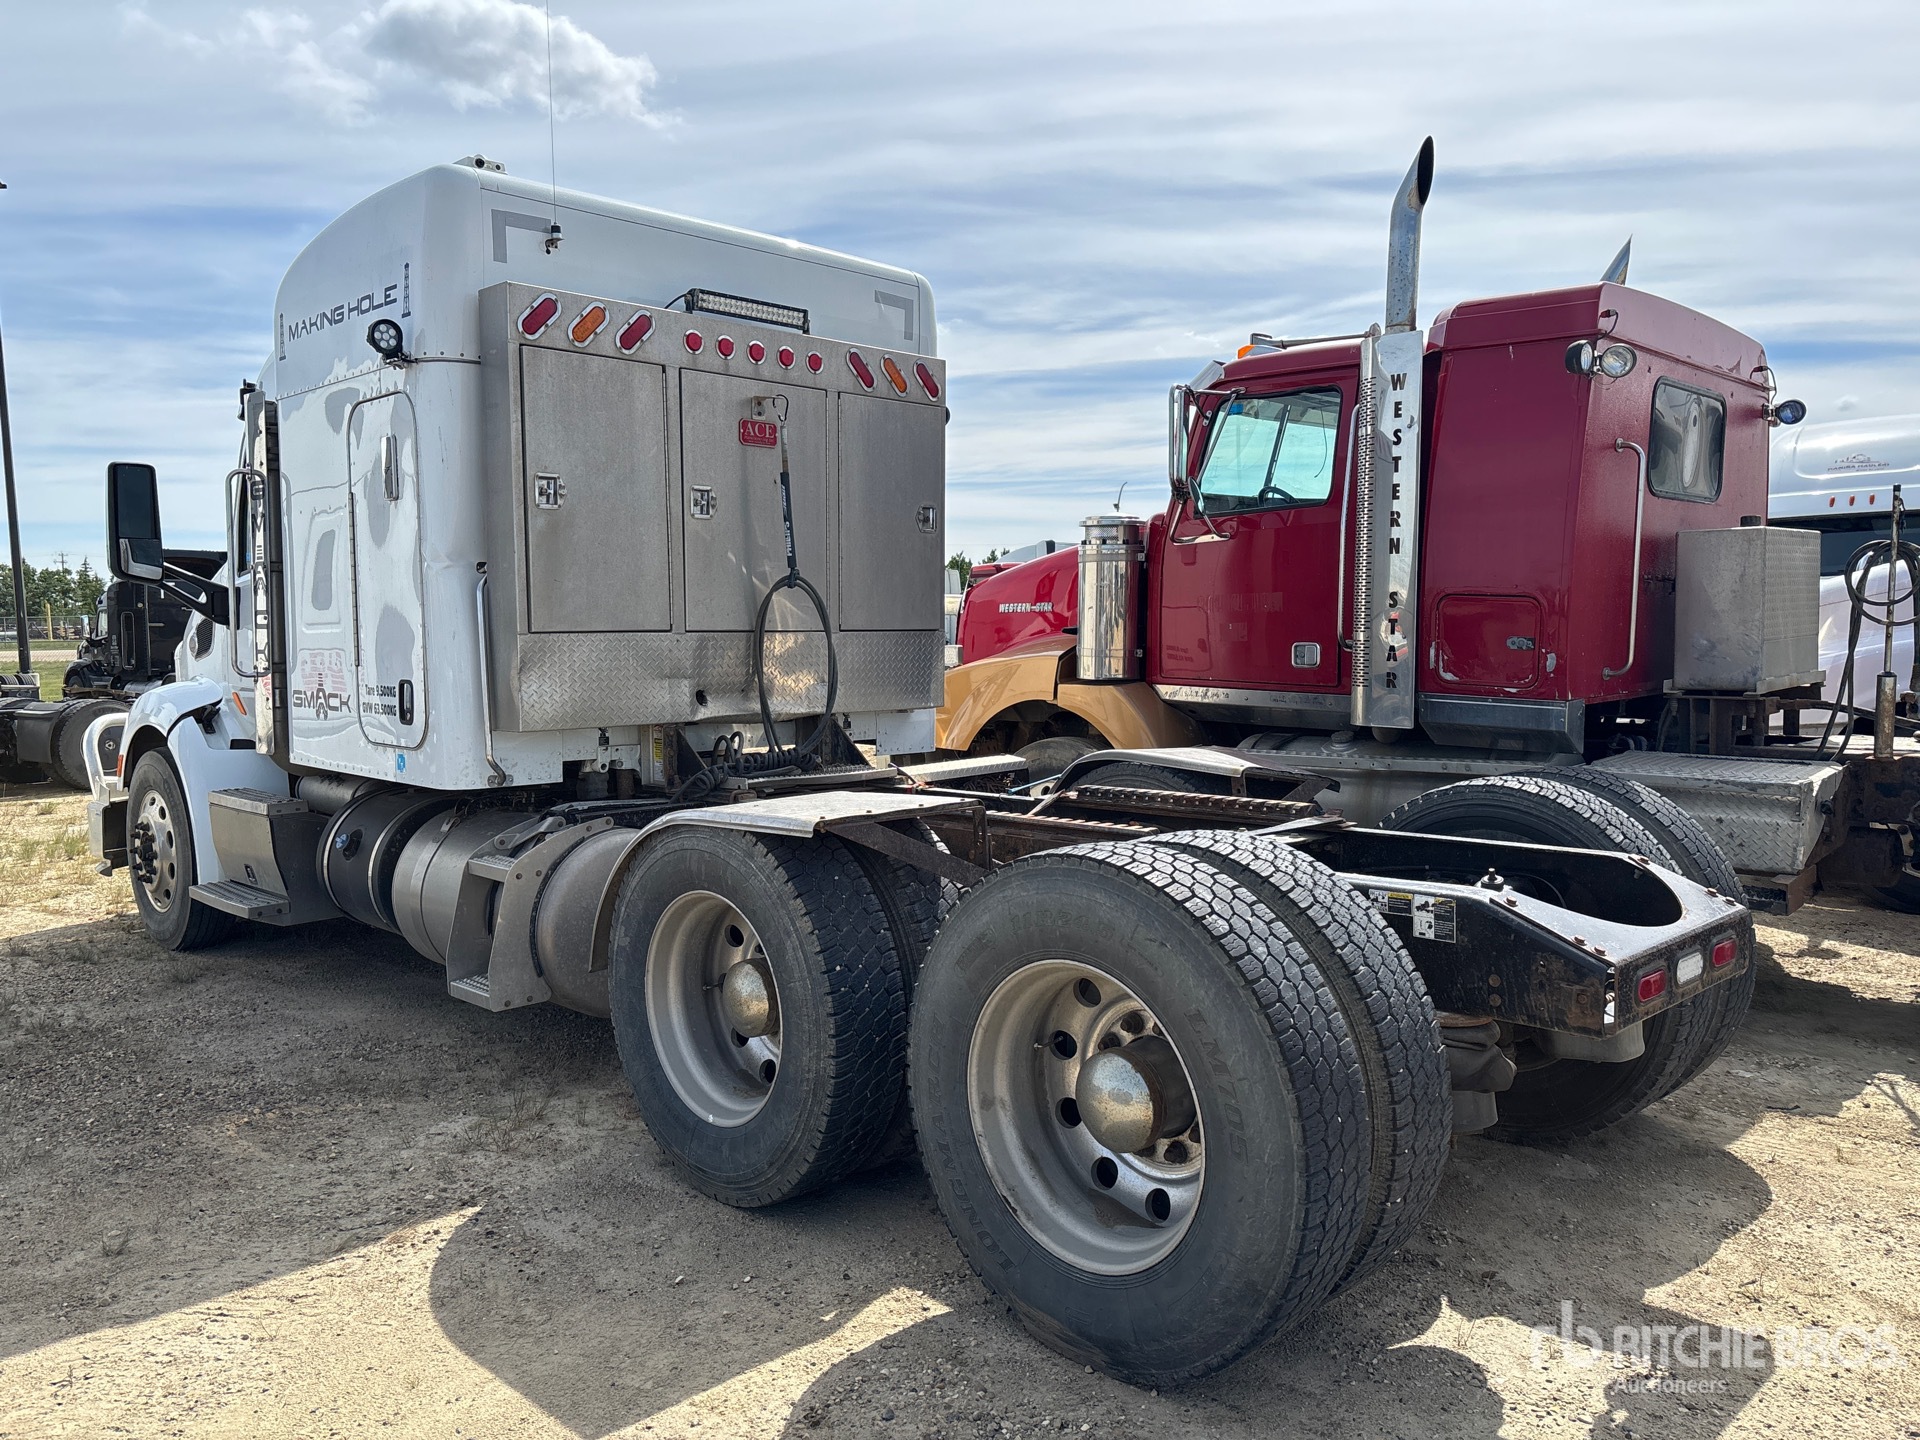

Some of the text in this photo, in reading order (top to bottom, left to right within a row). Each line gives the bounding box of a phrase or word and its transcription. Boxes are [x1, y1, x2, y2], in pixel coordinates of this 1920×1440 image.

[288, 283, 398, 342] MAKING HOLE
[744, 421, 775, 439] ACE
[1385, 373, 1408, 689] WESTERN STAR
[292, 687, 351, 718] GMACK
[365, 684, 375, 696] Tare
